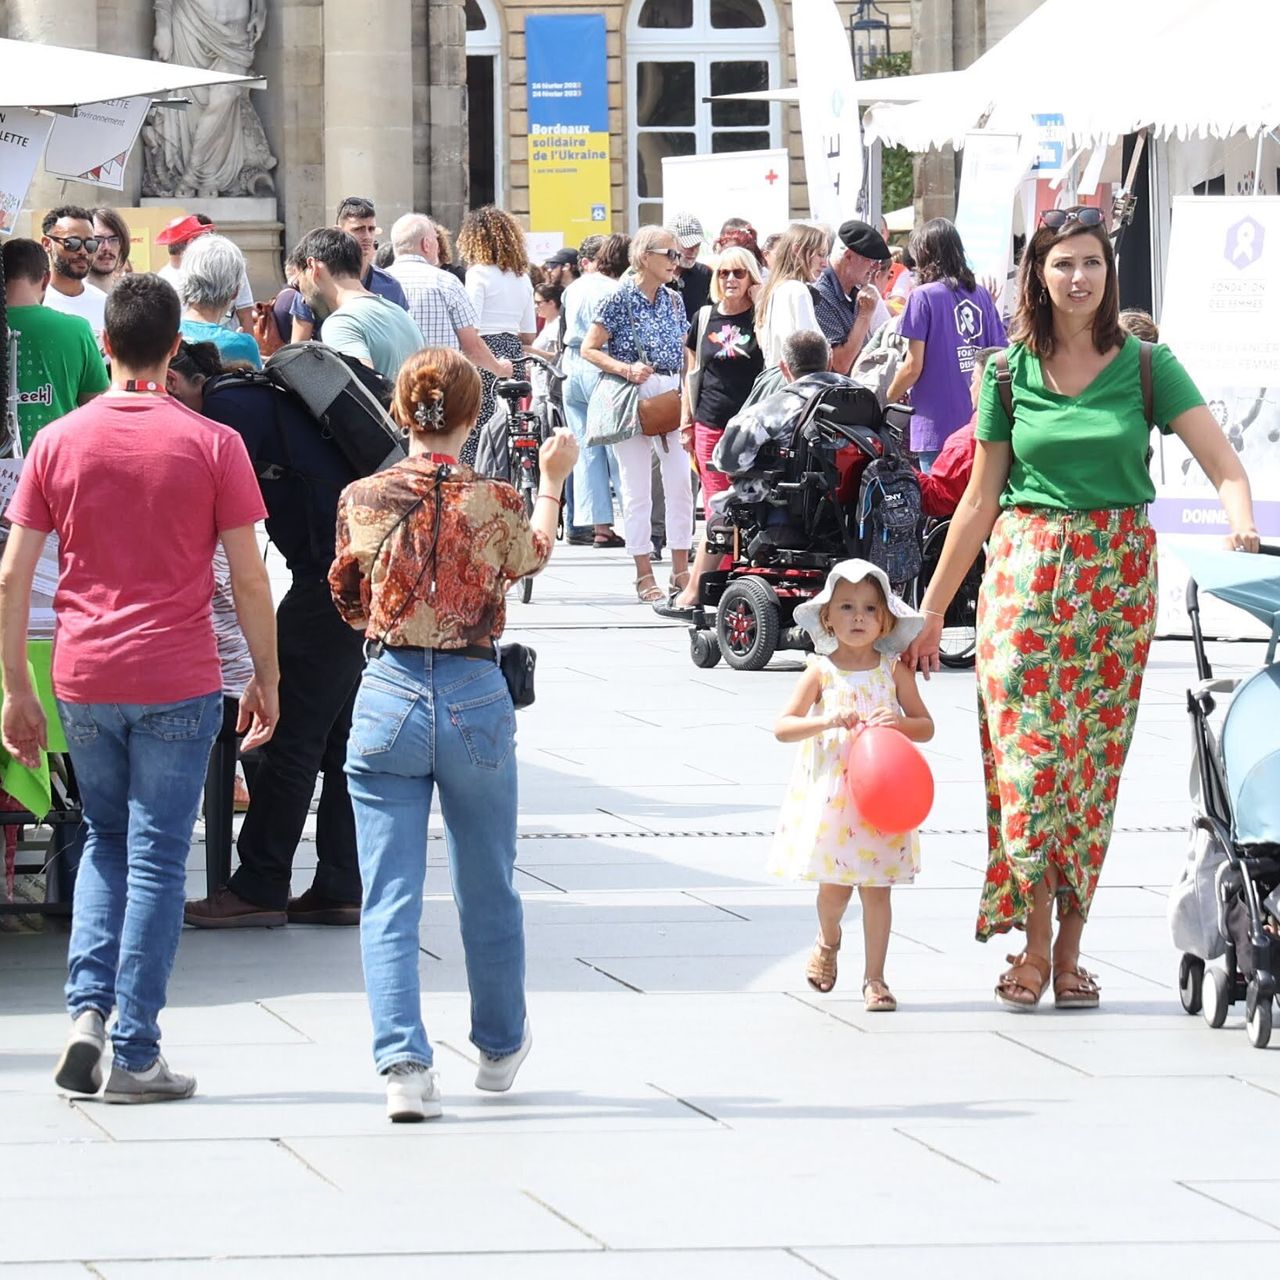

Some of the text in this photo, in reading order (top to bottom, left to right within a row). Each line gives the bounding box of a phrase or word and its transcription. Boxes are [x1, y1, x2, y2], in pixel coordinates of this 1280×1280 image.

[531, 124, 590, 135] Bordeaux
[532, 136, 587, 148] solidaire
[532, 150, 548, 161] de
